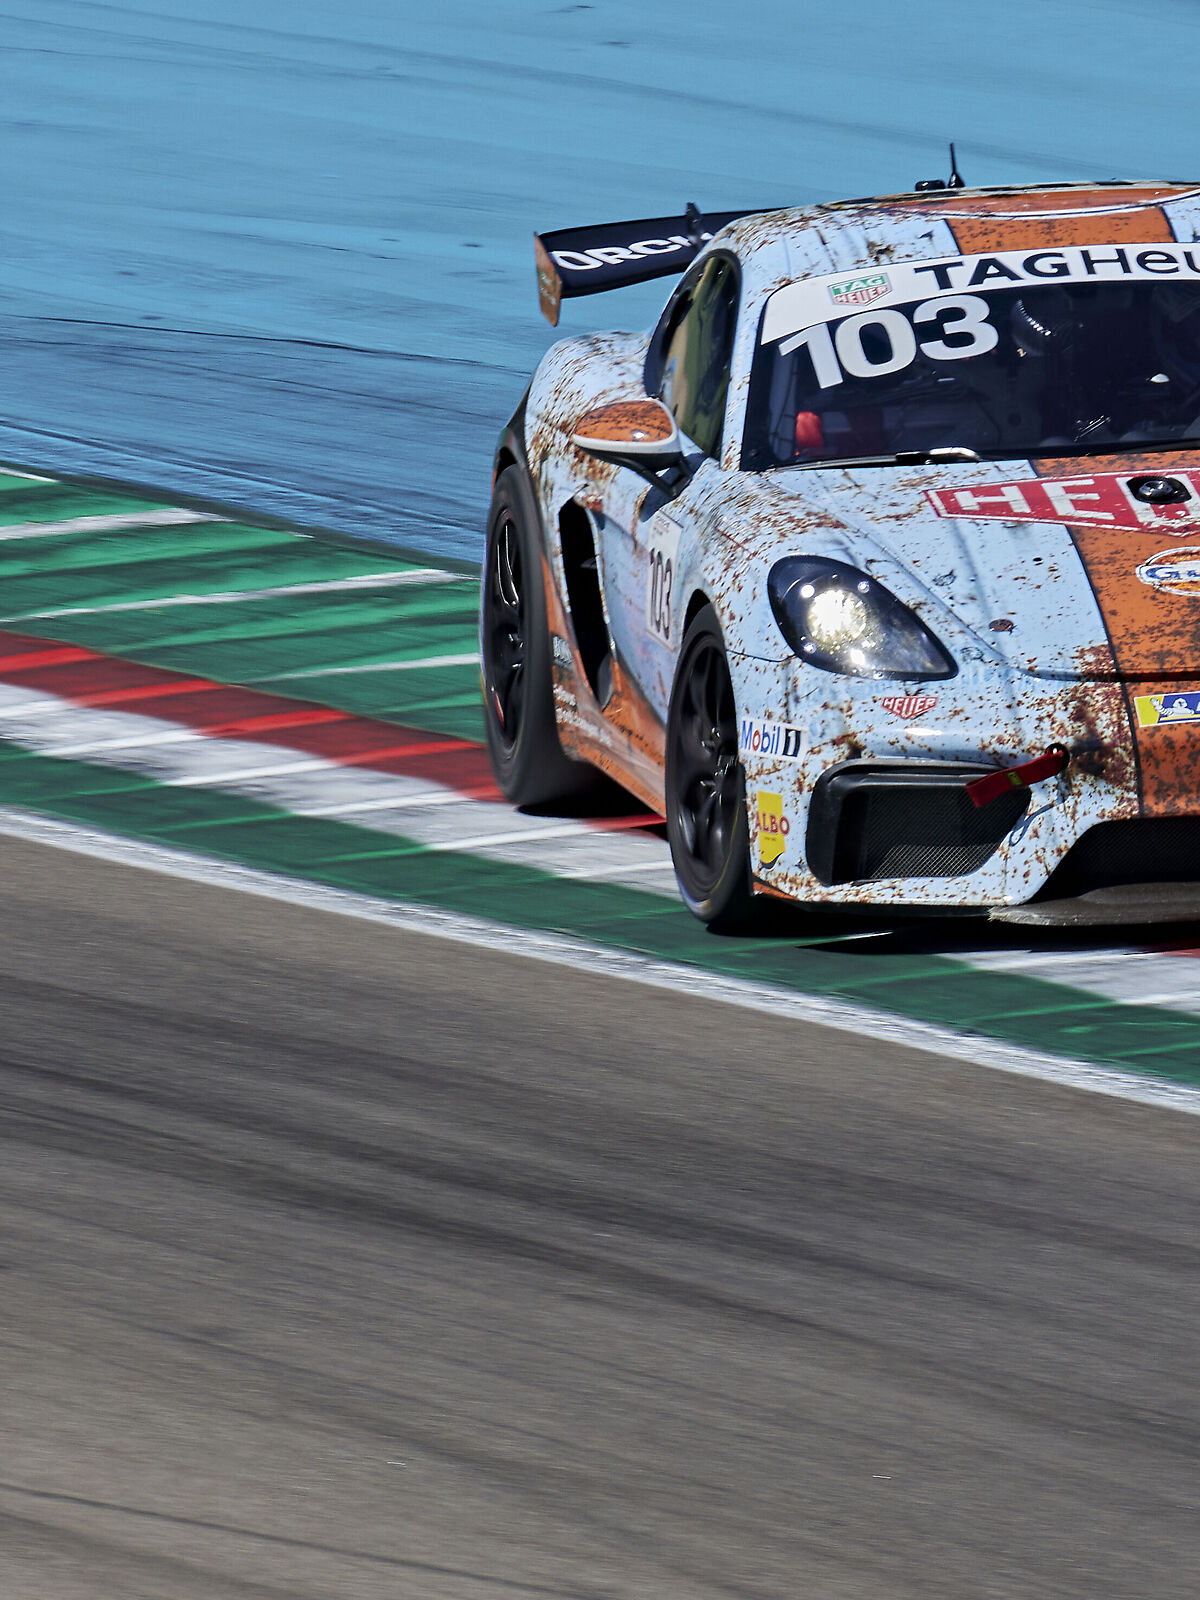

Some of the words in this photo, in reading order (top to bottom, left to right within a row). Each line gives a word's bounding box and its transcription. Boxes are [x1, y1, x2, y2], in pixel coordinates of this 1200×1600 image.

[832, 275, 885, 295] TAG
[778, 294, 999, 389] 103
[649, 547, 673, 640] 103
[883, 697, 936, 718] HEUER
[740, 720, 781, 755] Mobil
[755, 811, 790, 835] ALBO
